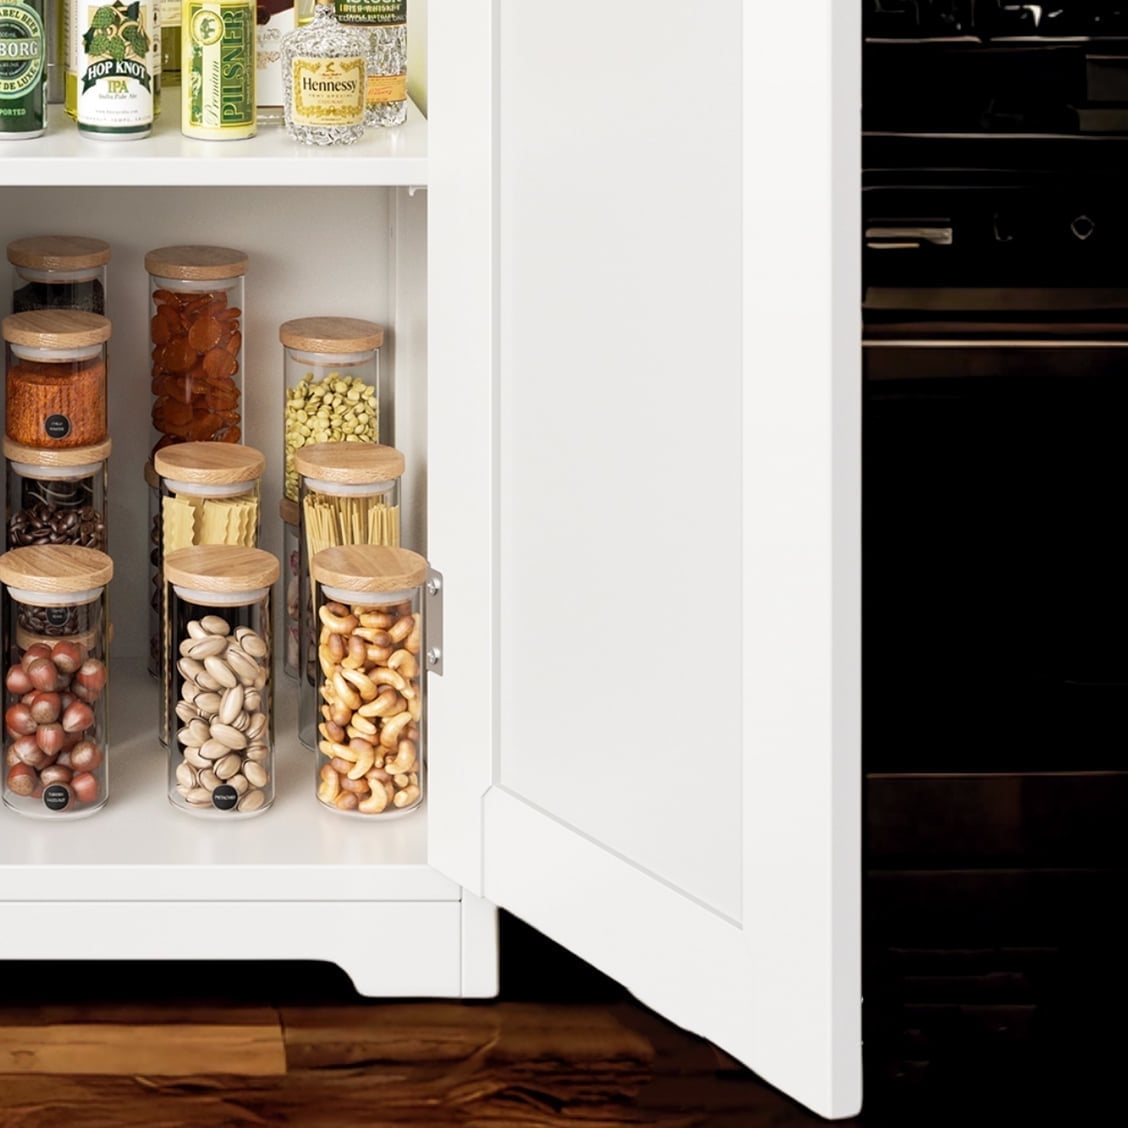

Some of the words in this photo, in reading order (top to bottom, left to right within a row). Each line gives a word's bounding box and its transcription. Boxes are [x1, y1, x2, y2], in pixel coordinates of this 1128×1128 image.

[20, 14, 39, 34] BEER
[88, 61, 113, 81] HOP
[115, 61, 145, 79] KNOT
[221, 9, 245, 123] PILSNER
[3, 81, 16, 91] DE
[19, 65, 37, 88] LUXE
[107, 80, 129, 94] IPA
[302, 76, 356, 94] Hennessy
[204, 59, 219, 126] Premium
